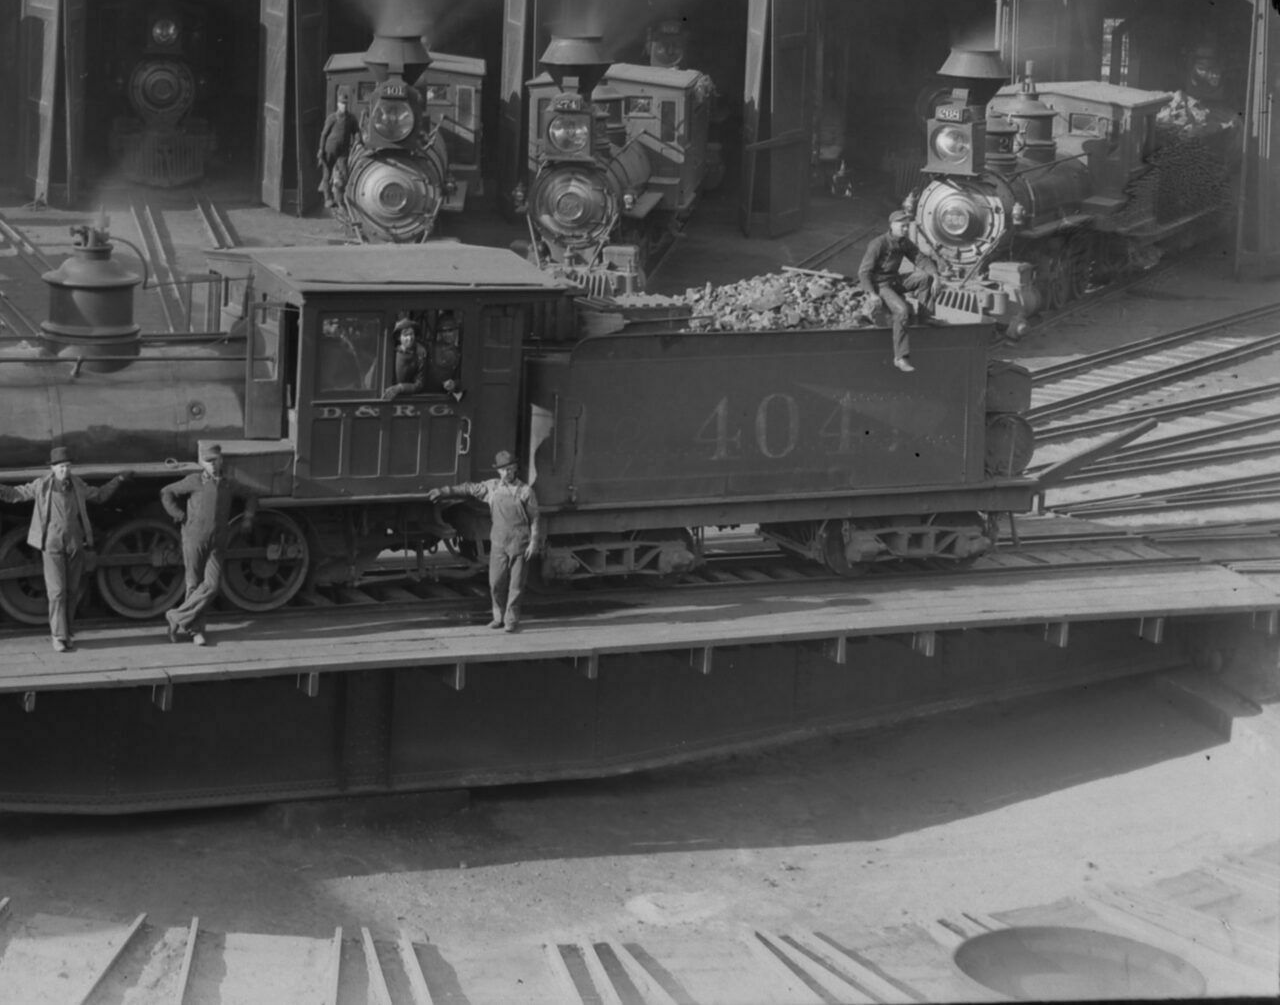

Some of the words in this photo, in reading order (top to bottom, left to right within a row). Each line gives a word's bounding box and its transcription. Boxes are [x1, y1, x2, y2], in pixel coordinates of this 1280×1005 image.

[320, 406, 347, 419] D.
[354, 404, 381, 418] &
[392, 404, 421, 417] R.
[428, 403, 455, 417] G.
[693, 390, 865, 461] 404
